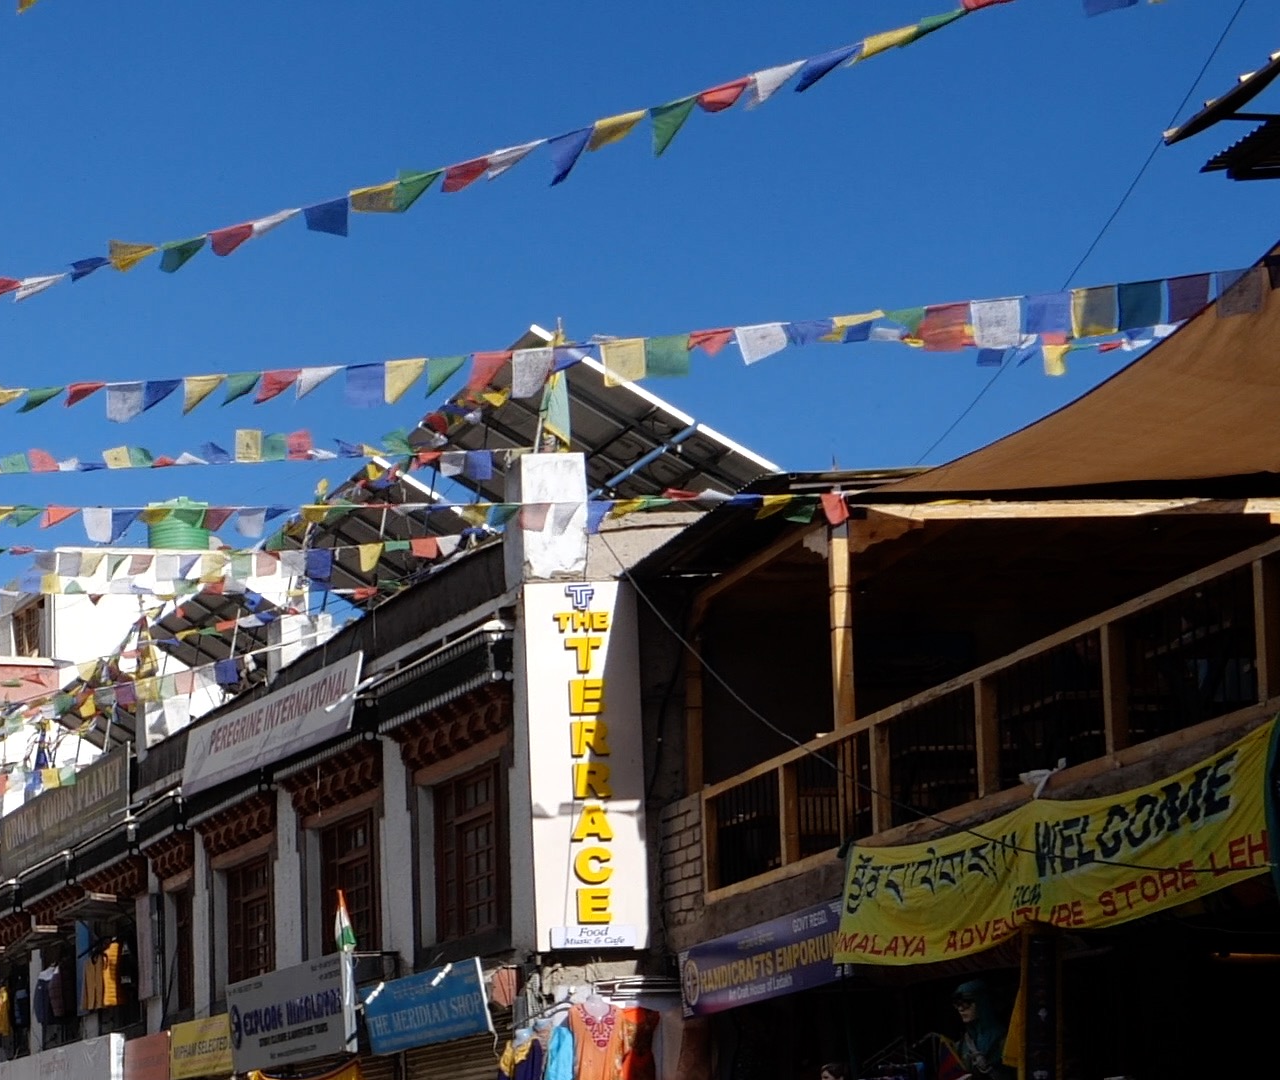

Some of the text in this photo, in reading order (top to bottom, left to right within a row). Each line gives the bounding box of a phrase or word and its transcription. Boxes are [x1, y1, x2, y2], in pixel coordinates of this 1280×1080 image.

[552, 611, 609, 634] THE
[208, 707, 265, 756] PEREGRINE
[263, 668, 348, 732] INTERNATIONAL
[564, 637, 615, 924] TERRACE
[1035, 750, 1239, 878] WELCOME
[1098, 860, 1199, 917] STORE
[1209, 830, 1269, 877] LEH
[578, 926, 610, 937] Food
[604, 936, 626, 946] Cafe
[698, 950, 774, 994] HANDICRAFTS
[243, 1004, 284, 1037] EXPLORE
[366, 1014, 390, 1038] THE
[391, 999, 449, 1032] MERIDIAN
[450, 991, 482, 1016] SHOP
